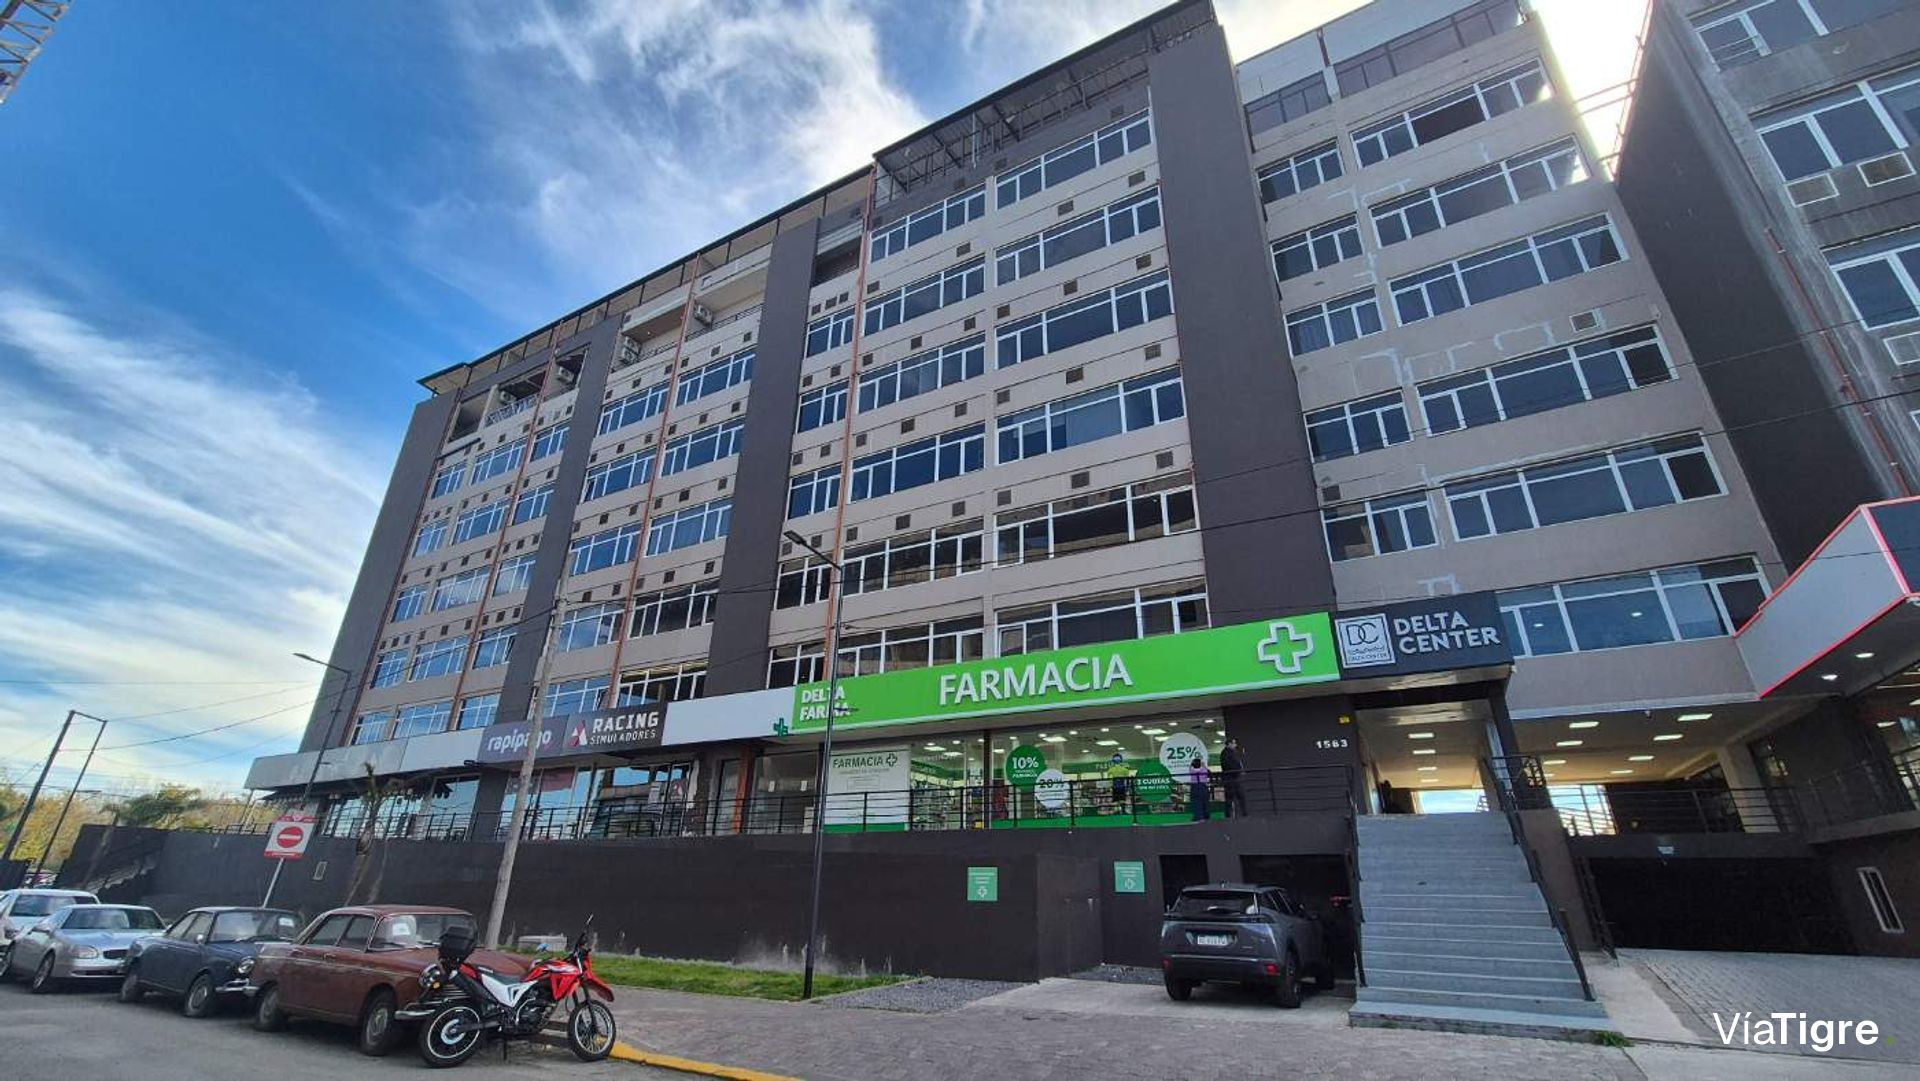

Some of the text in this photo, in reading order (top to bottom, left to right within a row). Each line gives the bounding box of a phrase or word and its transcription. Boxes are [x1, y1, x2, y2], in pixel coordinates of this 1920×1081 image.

[1394, 611, 1469, 636] DELTA
[1399, 627, 1501, 654] CENTER
[939, 653, 1133, 706] FARMACIA
[592, 711, 659, 733] RACING
[590, 730, 657, 744] SIMULADORES
[832, 756, 884, 768] FARMACIA
[1166, 747, 1201, 760] 25%
[1012, 757, 1039, 769] 10%
